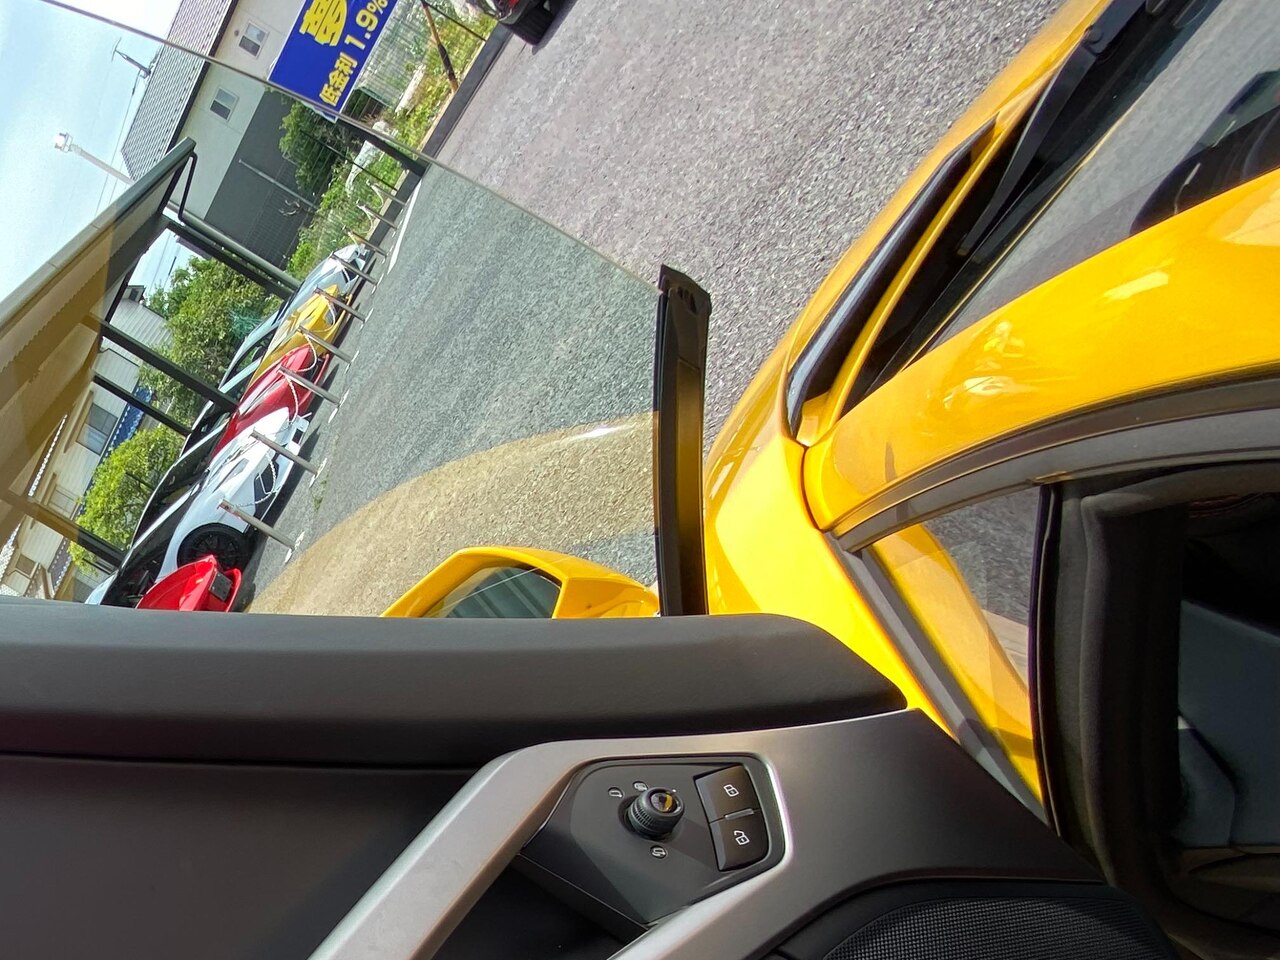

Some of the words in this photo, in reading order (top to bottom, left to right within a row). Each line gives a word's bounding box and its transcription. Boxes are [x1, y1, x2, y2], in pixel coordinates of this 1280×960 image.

[319, 52, 358, 107] 低金利
[344, 0, 389, 50] 1.9%
